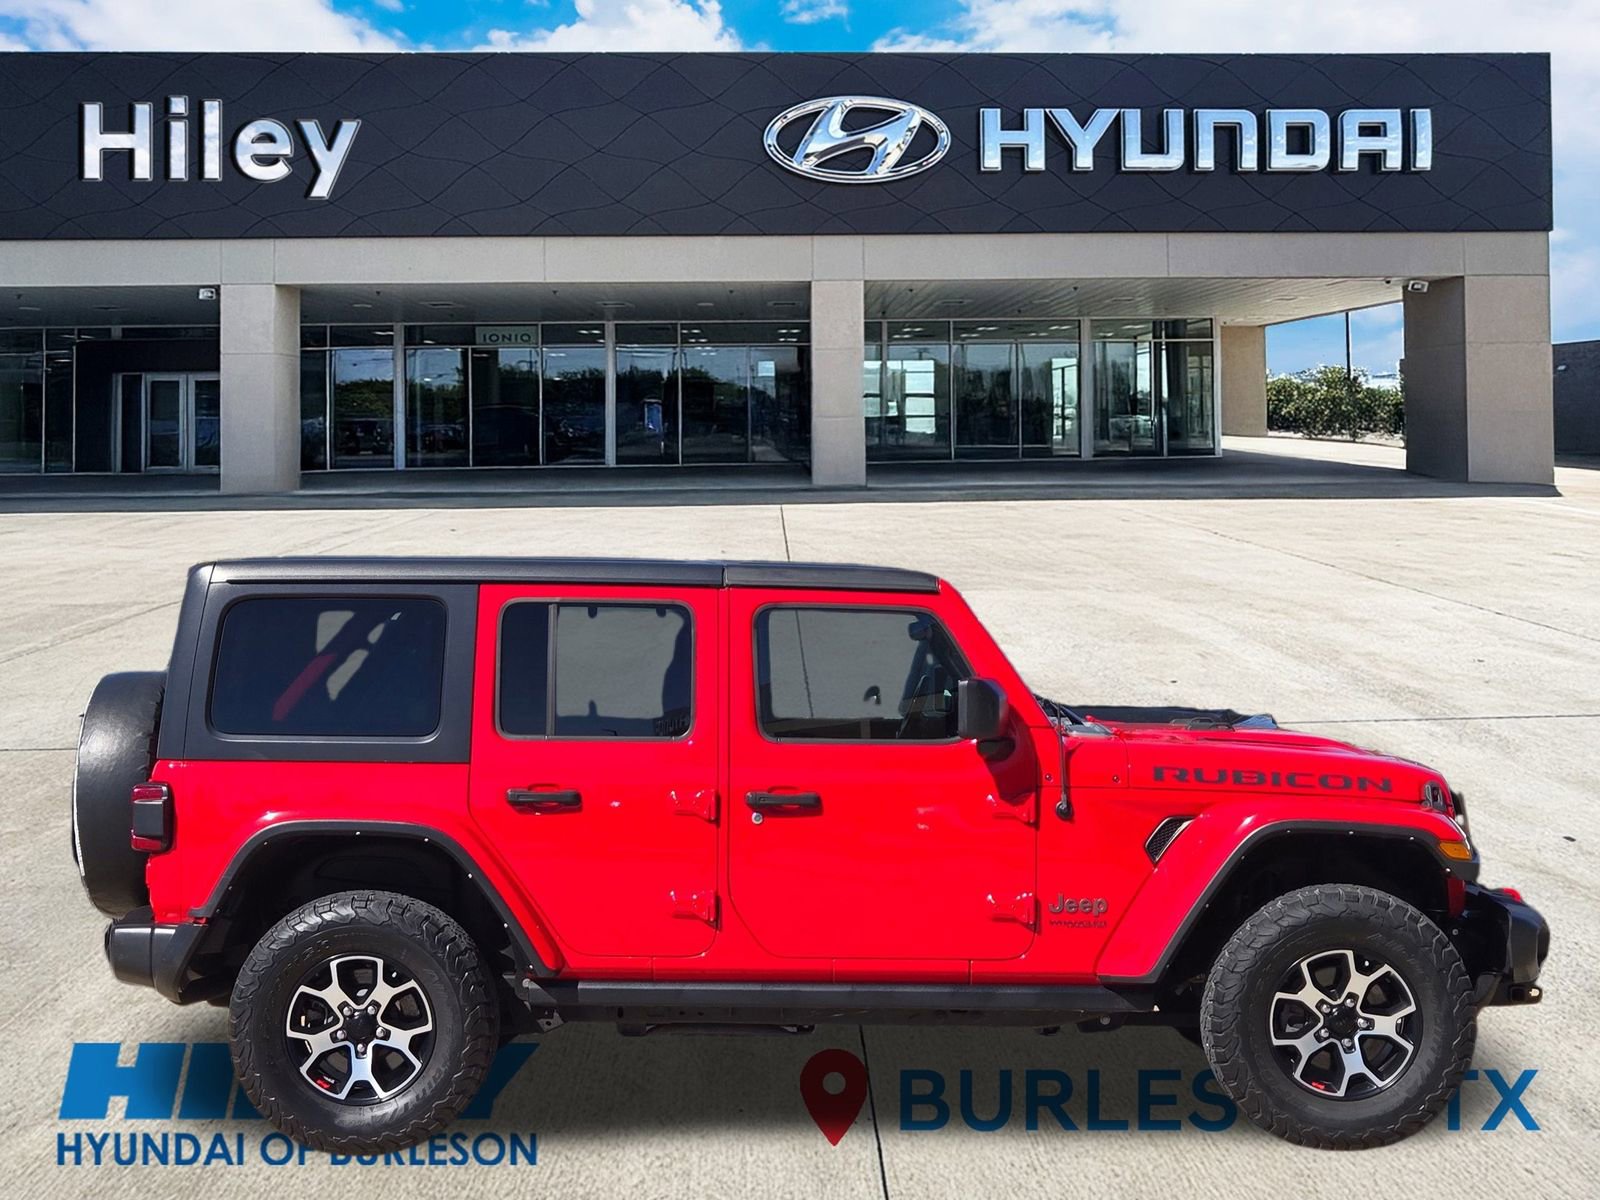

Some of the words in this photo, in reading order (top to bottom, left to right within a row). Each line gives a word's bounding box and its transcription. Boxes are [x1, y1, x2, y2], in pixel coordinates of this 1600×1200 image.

[80, 95, 361, 199] Hiley
[979, 107, 1433, 173] HYUNDAI
[1152, 765, 1394, 793] RUBICON
[1048, 892, 1108, 917] Jeep
